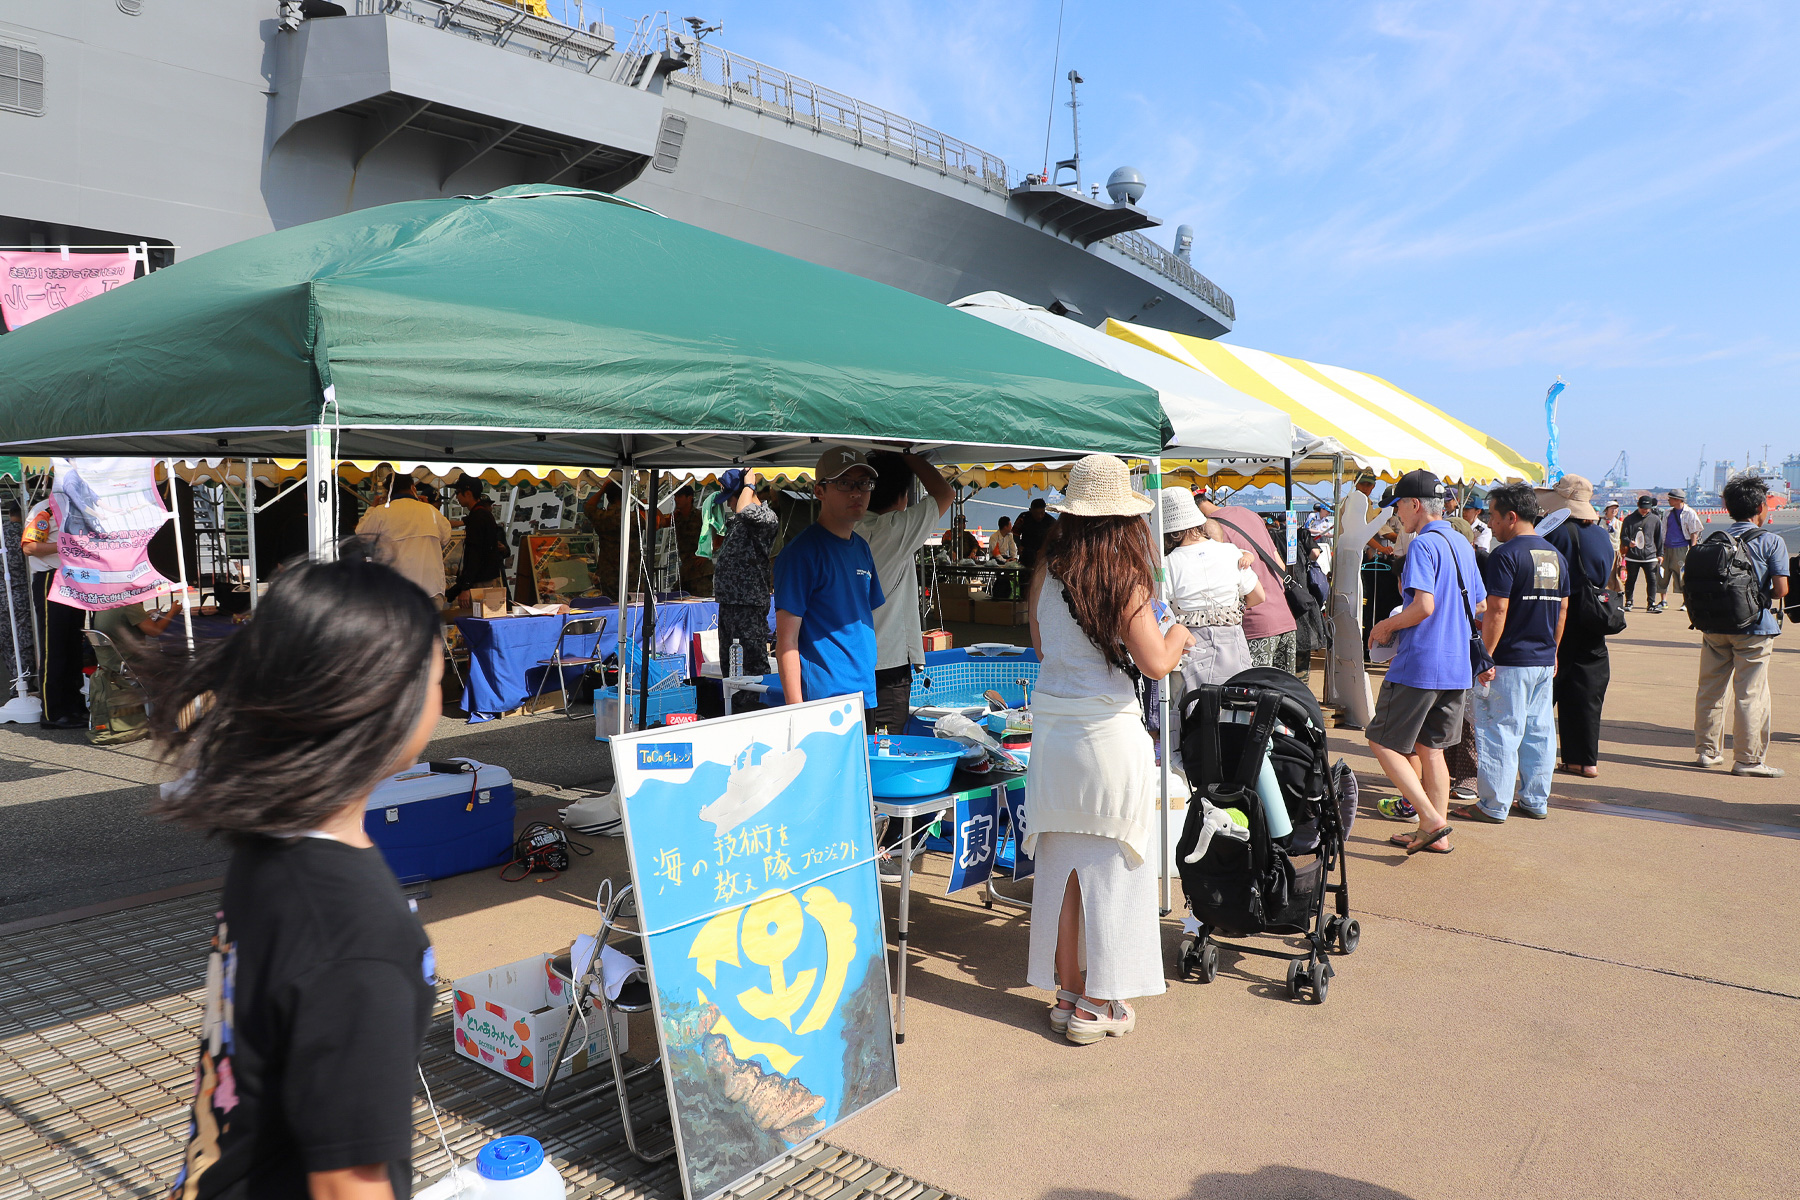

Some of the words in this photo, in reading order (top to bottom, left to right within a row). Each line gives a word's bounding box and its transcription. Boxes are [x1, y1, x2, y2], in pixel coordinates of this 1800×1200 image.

[841, 451, 857, 464] N
[670, 716, 692, 725] SAVAS
[713, 823, 791, 867] 技術を
[961, 816, 991, 867] 東
[589, 1042, 597, 1054] M
